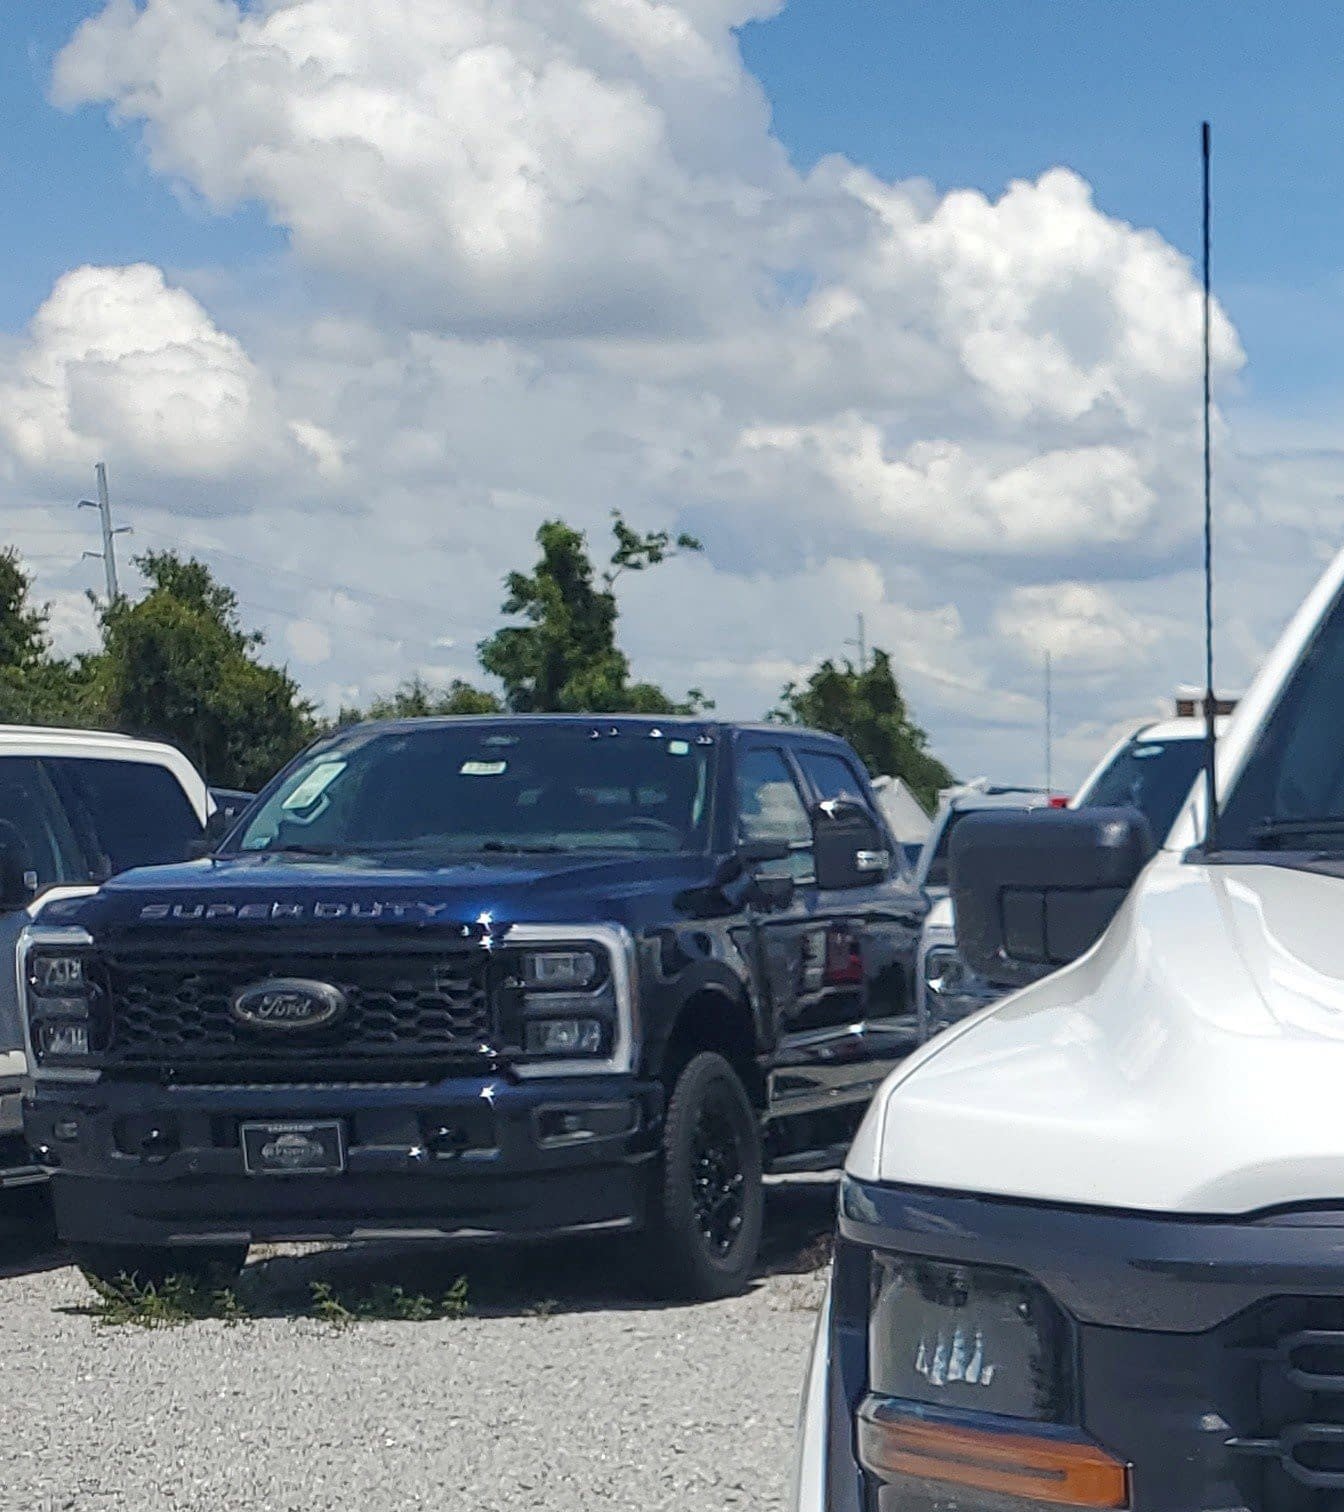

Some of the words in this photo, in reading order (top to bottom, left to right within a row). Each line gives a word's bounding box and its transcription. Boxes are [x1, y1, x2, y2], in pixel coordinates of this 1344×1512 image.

[140, 902, 304, 920] SUPER
[313, 902, 447, 918] DUTY
[258, 995, 312, 1018] Ford
